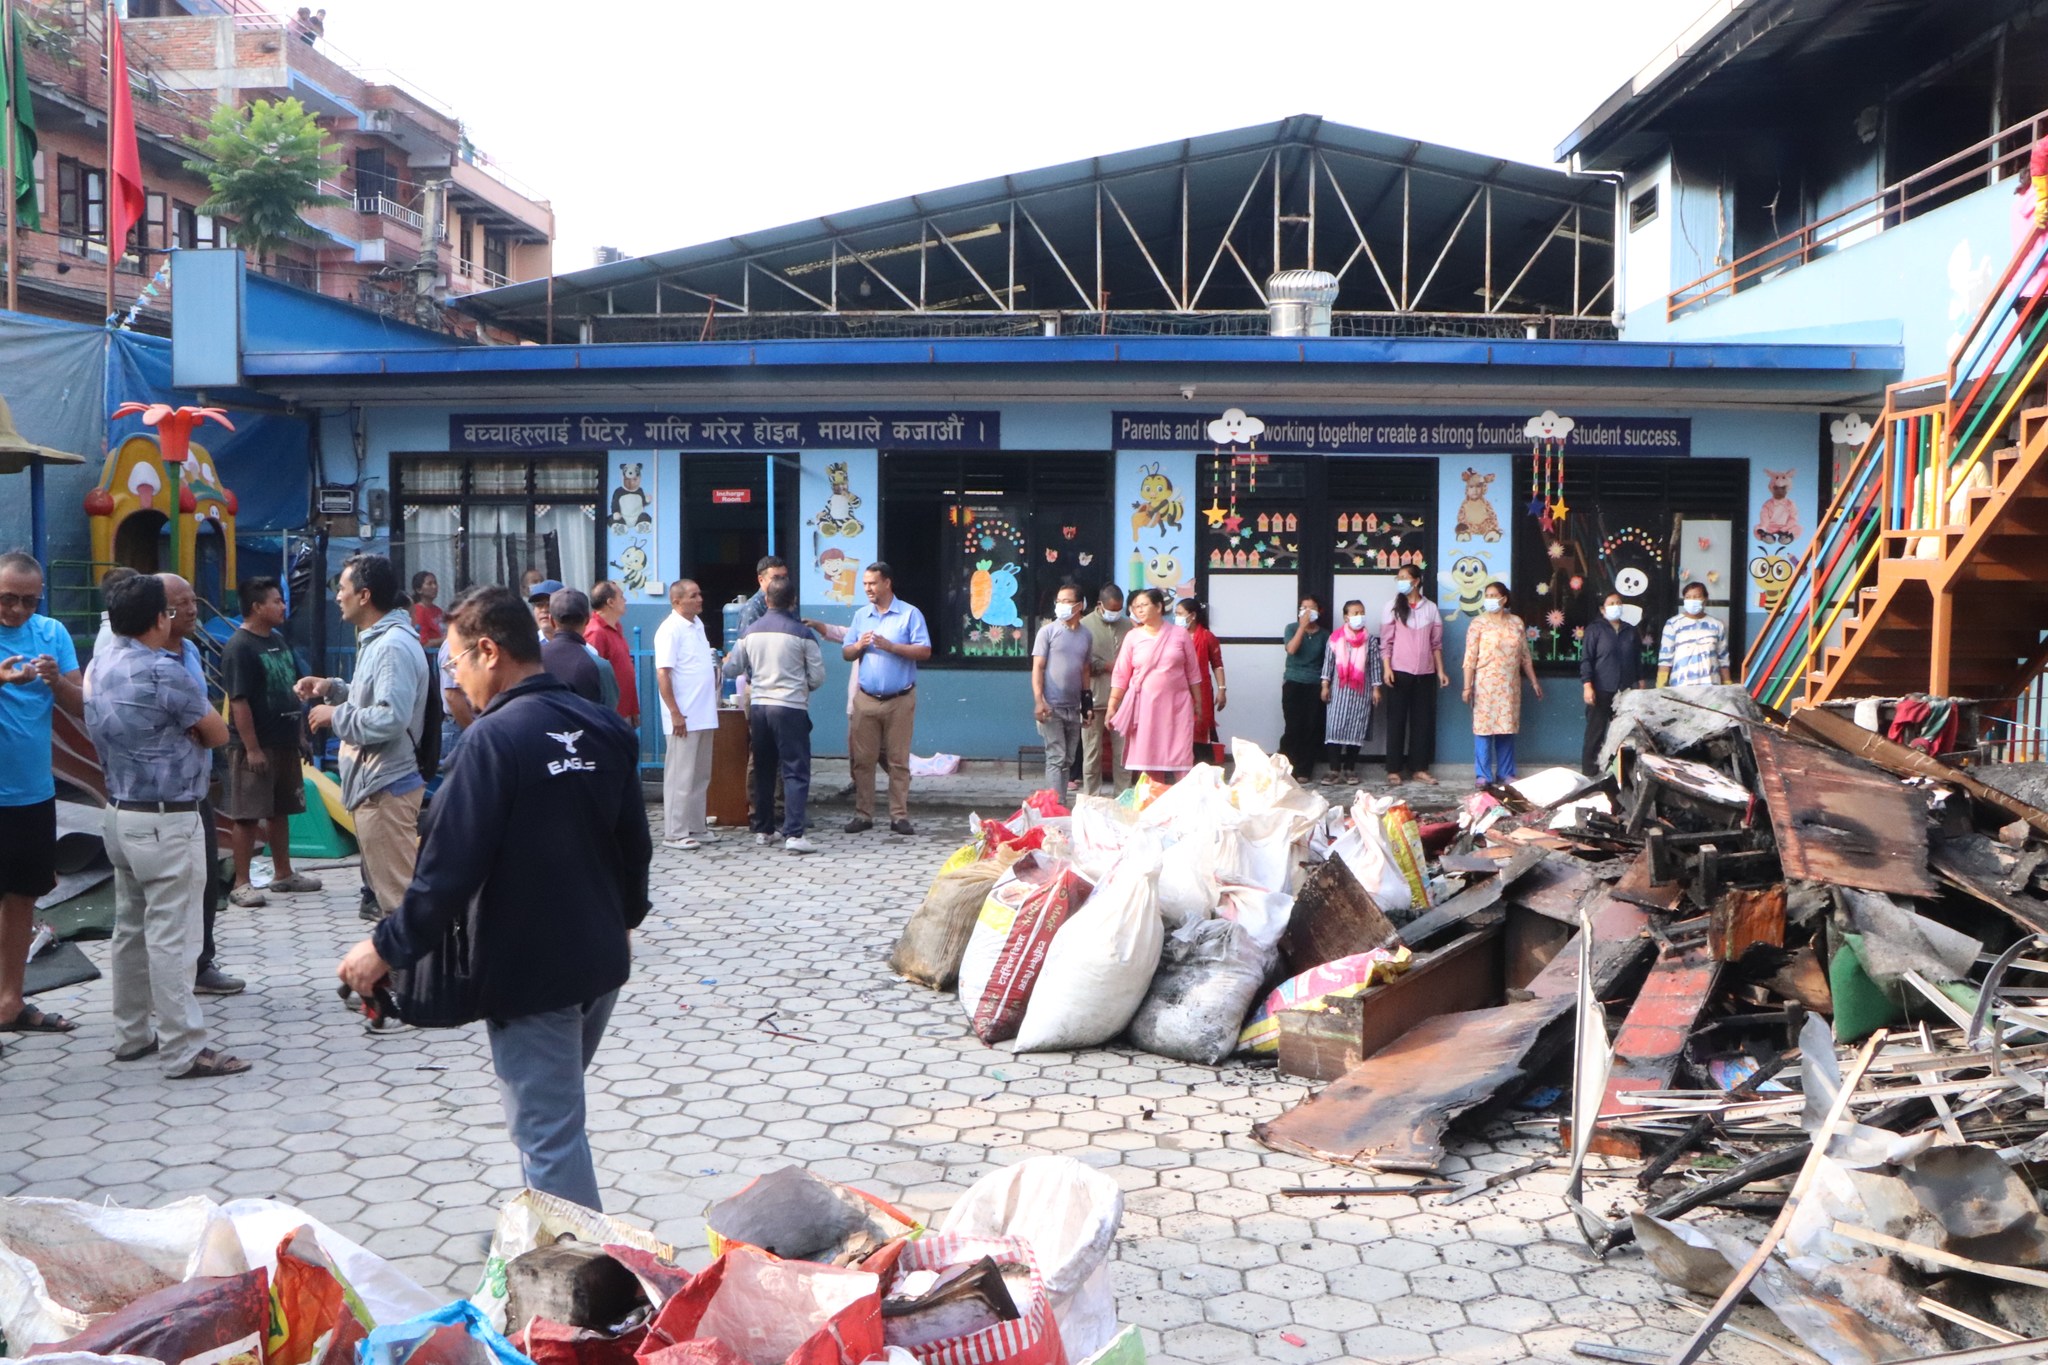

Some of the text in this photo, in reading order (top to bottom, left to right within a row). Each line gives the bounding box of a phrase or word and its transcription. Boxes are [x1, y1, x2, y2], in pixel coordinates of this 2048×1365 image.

[464, 417, 571, 446] बच्चाहरुलाई
[580, 416, 632, 447] पिटेर,
[644, 415, 692, 443] गालि
[701, 417, 744, 445] गरेर
[753, 417, 806, 446] होइन,
[818, 416, 883, 442] मायाले
[892, 413, 965, 441] कजाऔं
[1121, 418, 1171, 440] Parents
[1175, 419, 1199, 441] and
[1263, 422, 1315, 448] working
[1318, 422, 1373, 449] together
[1377, 424, 1417, 443] create
[1420, 427, 1428, 443] a
[1431, 424, 1474, 449] strong
[1572, 423, 1621, 447] student
[1624, 428, 1681, 447] success.
